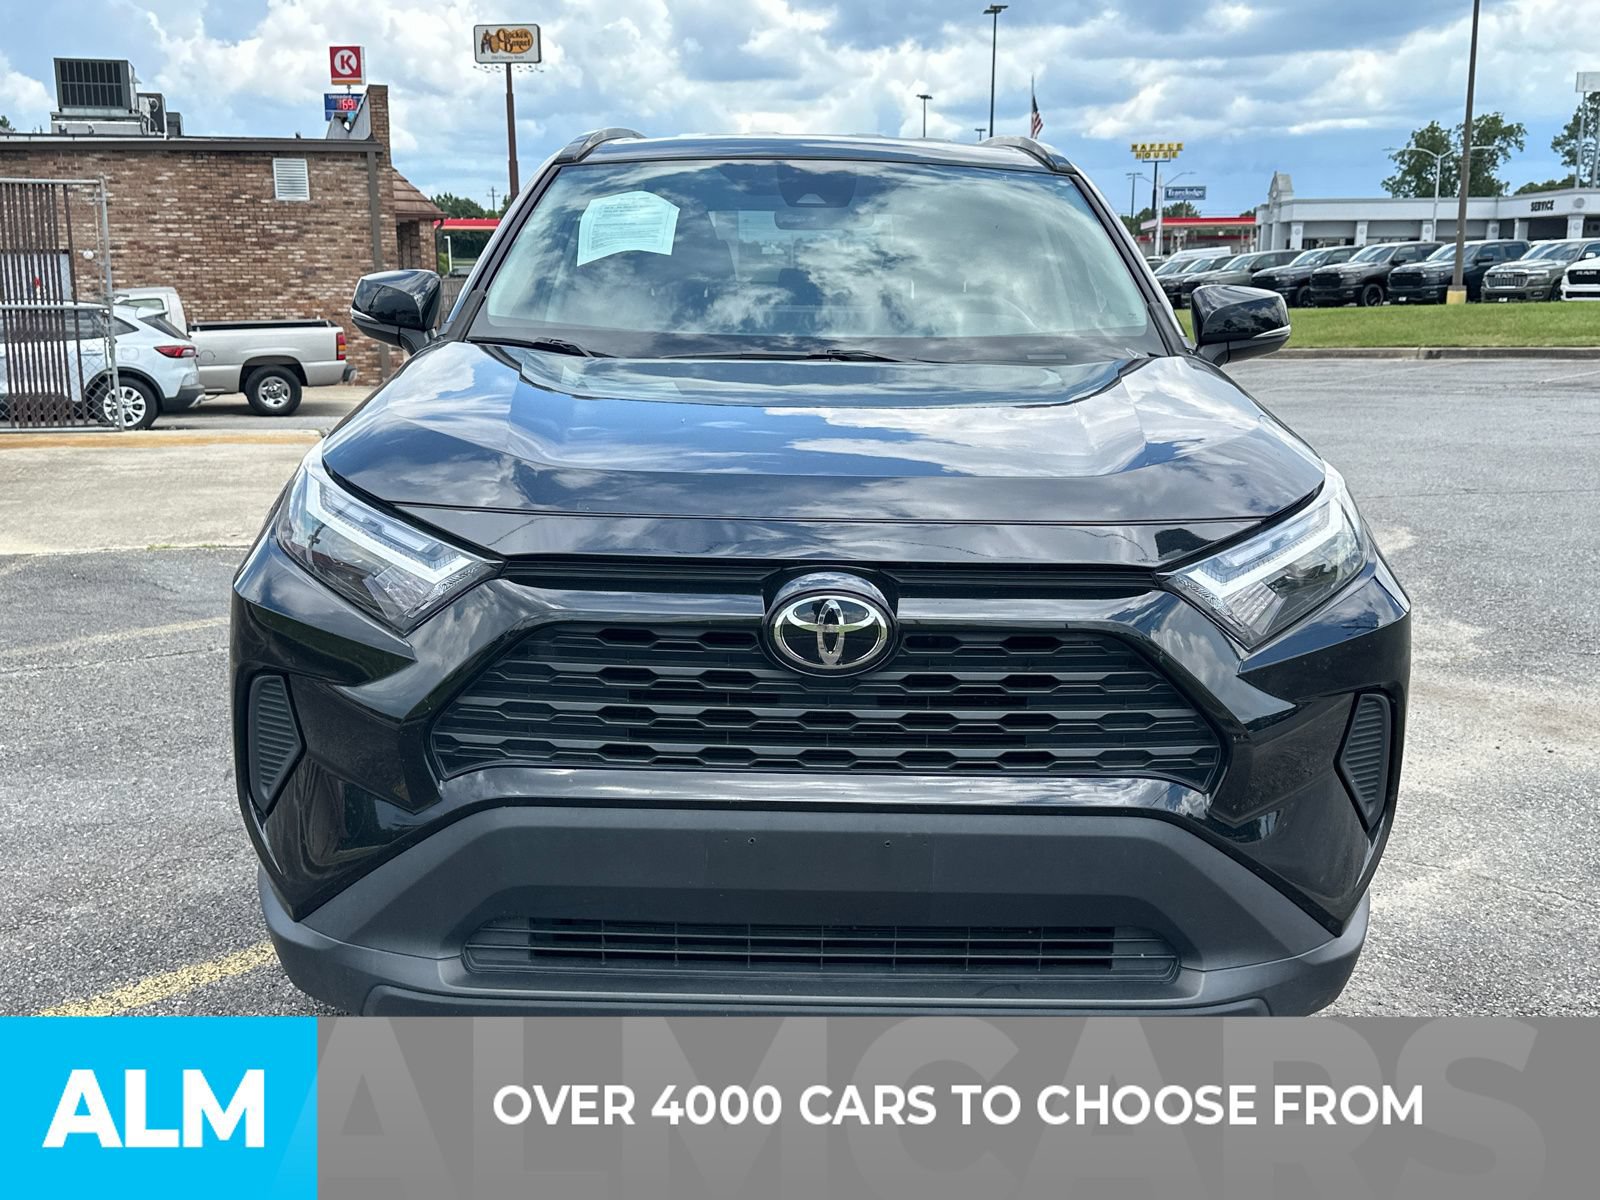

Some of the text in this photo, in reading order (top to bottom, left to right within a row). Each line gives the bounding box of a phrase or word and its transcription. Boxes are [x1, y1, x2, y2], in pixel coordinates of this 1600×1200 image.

[1131, 143, 1183, 151] WAFFLE
[1136, 151, 1178, 159] HOUSE
[1531, 200, 1555, 211] SERVICE
